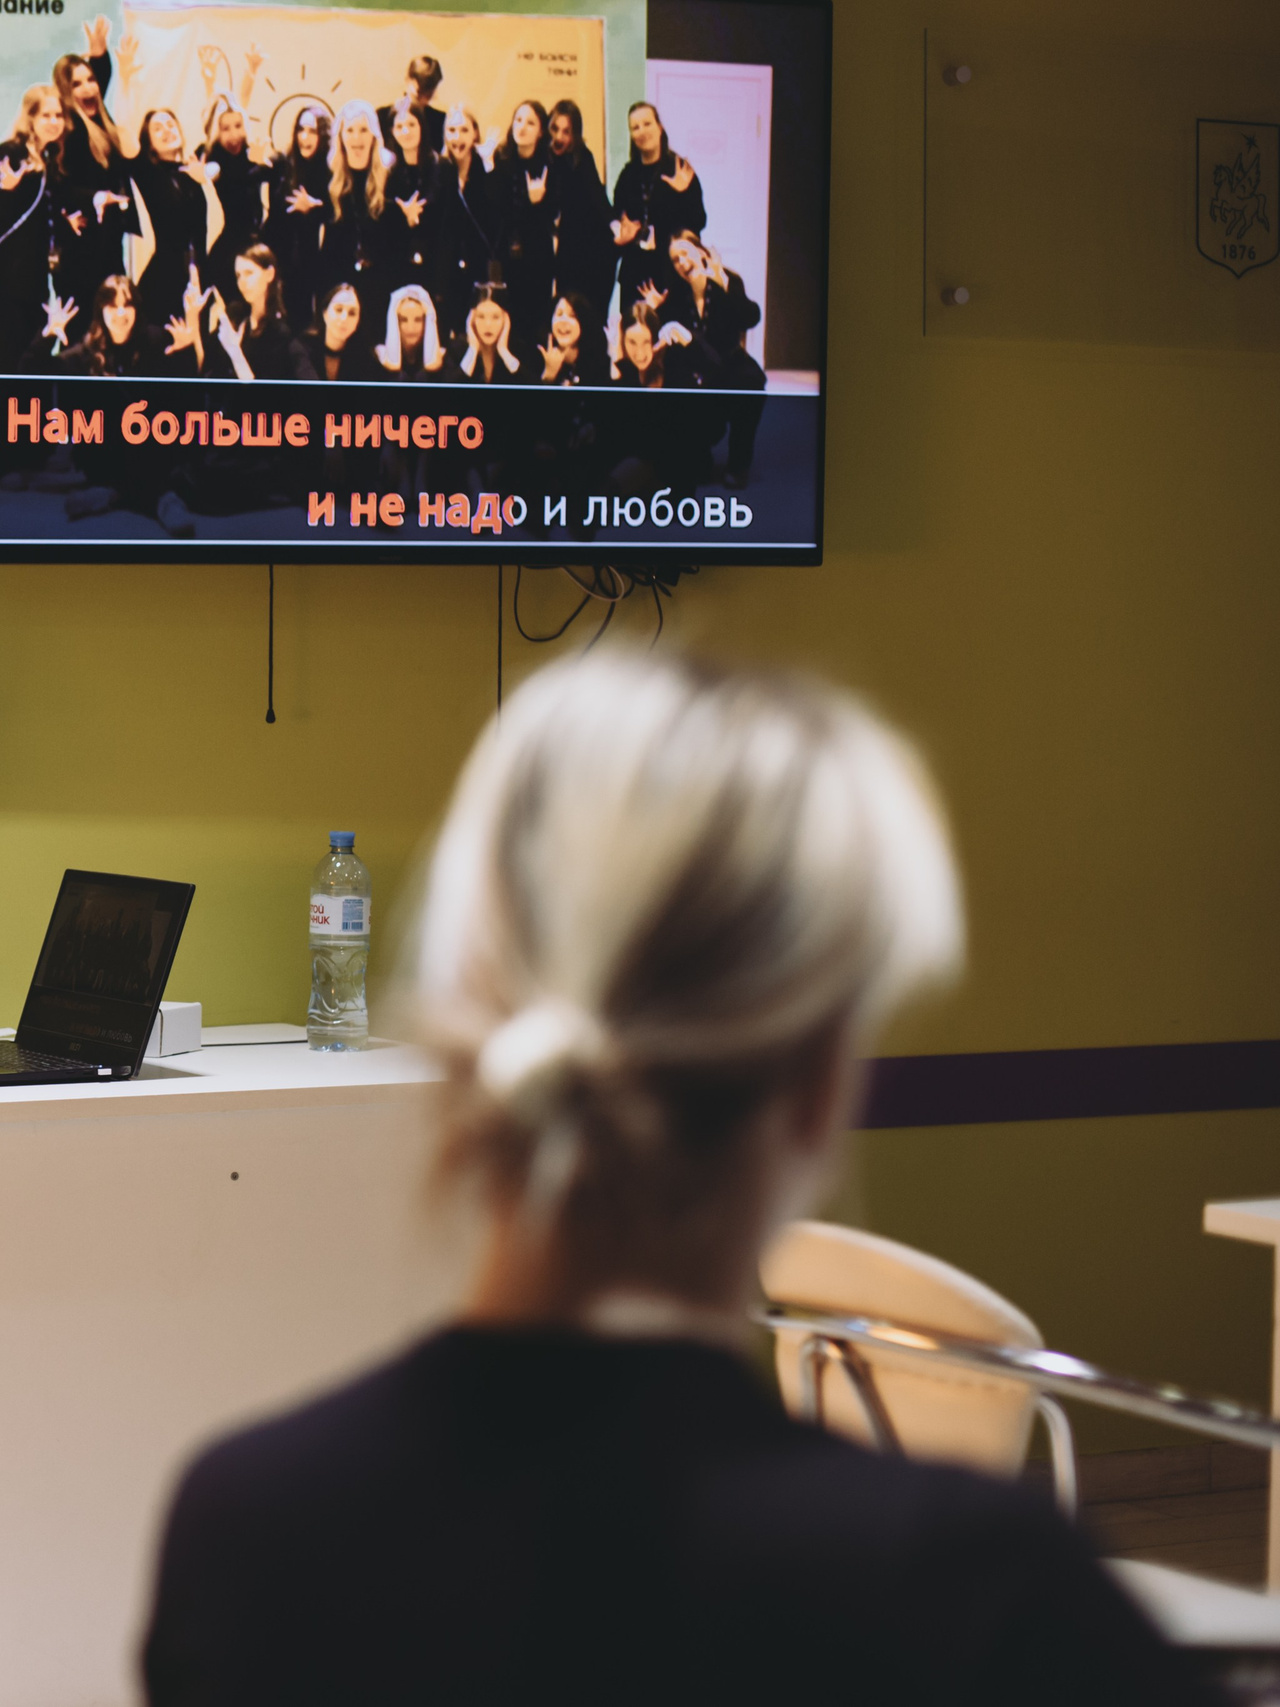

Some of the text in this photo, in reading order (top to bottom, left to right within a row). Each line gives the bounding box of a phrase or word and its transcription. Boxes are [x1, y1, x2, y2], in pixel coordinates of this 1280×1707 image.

[1222, 244, 1256, 260] 1876
[7, 397, 484, 449] Нам больше ничего
[307, 487, 753, 534] и не надо и любовь
